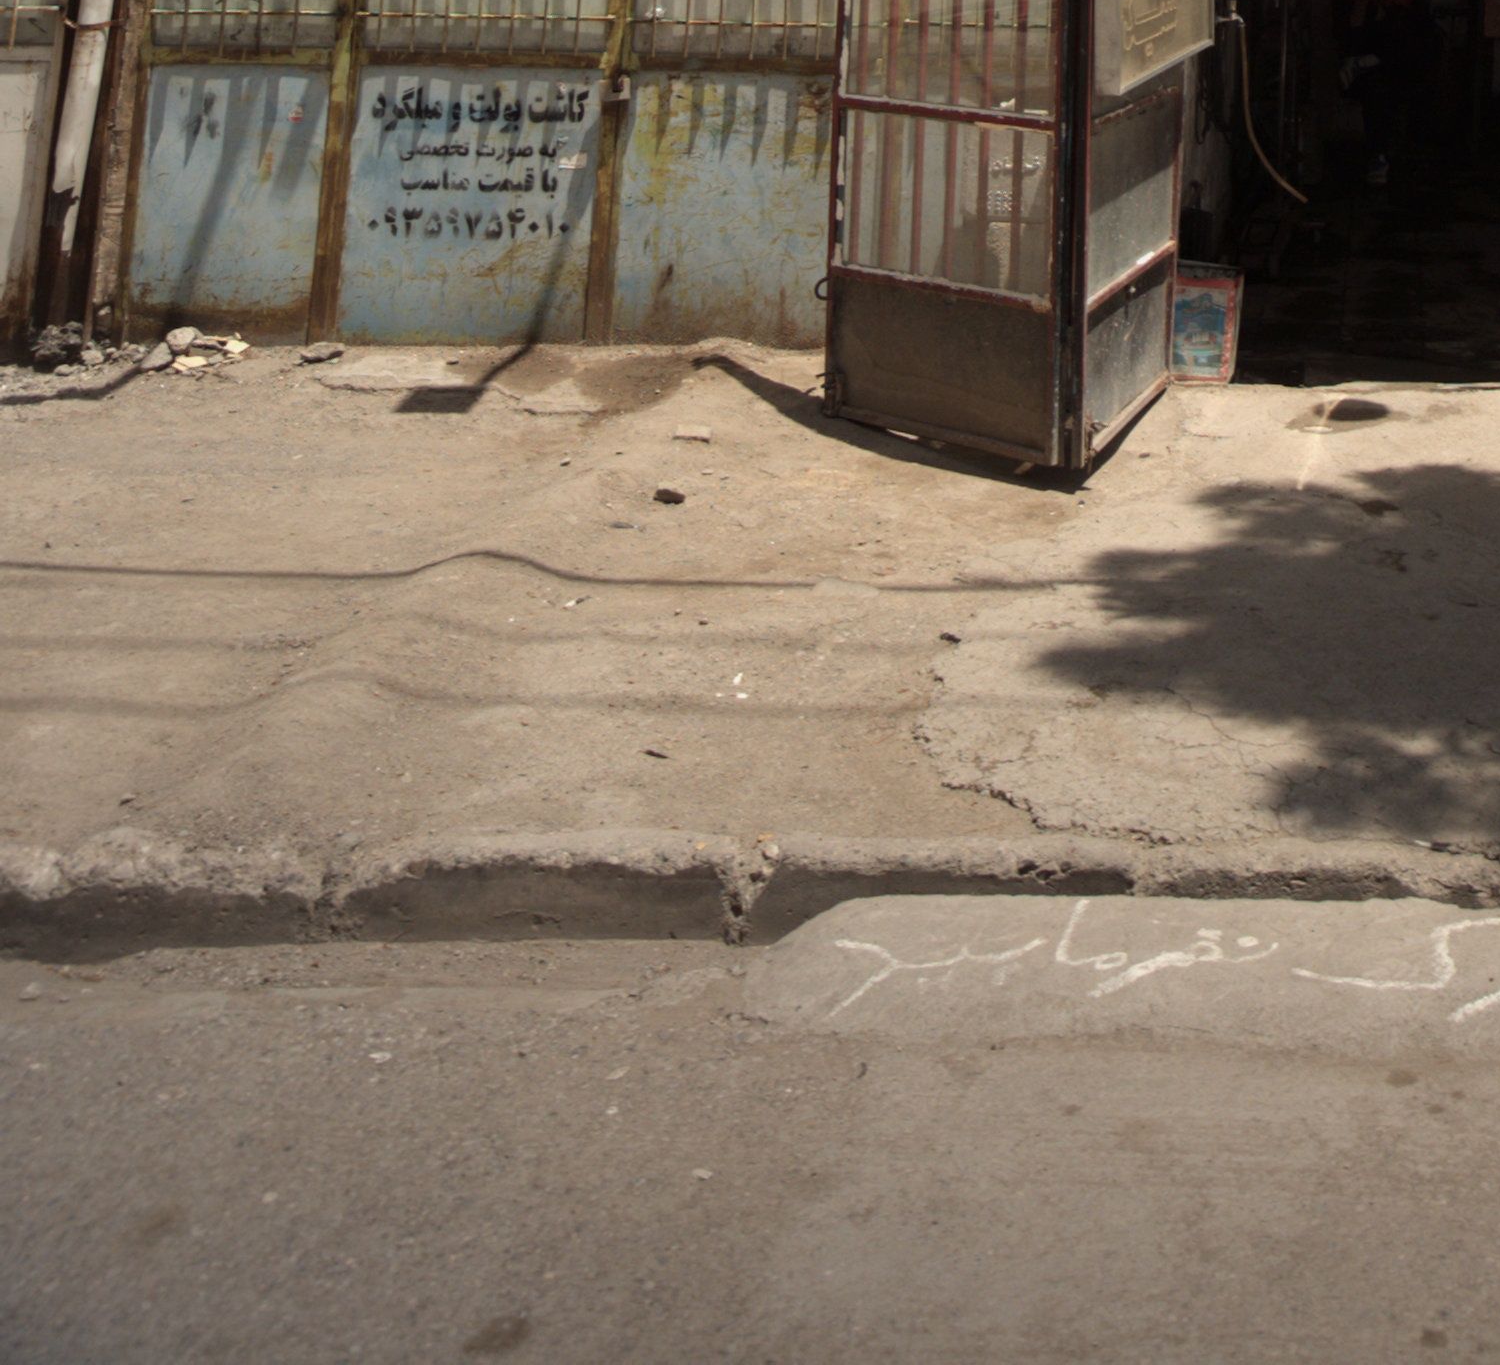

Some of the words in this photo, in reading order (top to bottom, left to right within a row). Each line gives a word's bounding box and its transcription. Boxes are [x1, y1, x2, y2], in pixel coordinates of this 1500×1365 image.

[528, 87, 591, 124] کاشت
[475, 140, 534, 164] صورت
[539, 141, 558, 164] به
[400, 168, 470, 196] مناسب
[478, 167, 535, 199] قیمت
[541, 168, 558, 199] با
